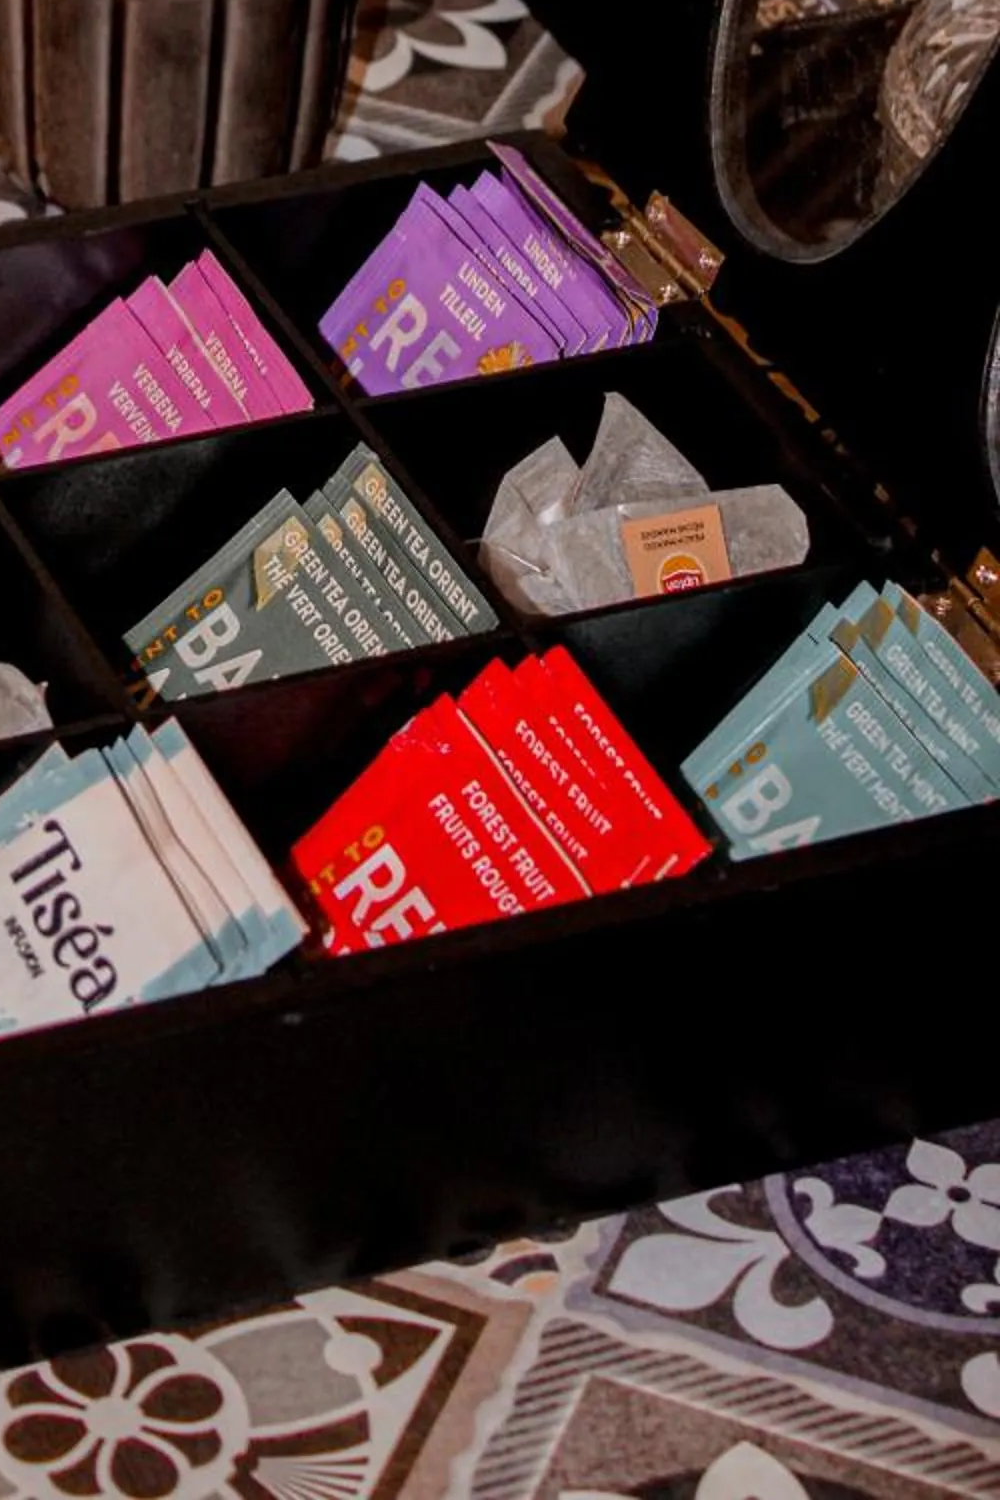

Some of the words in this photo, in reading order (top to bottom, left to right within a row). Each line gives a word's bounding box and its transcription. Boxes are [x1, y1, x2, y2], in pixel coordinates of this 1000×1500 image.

[459, 261, 506, 318] LINDEN
[523, 233, 563, 290] LINDEN
[440, 283, 487, 341] TILLEUL
[132, 363, 183, 434] VERBENA
[284, 531, 329, 586] GREEN
[321, 576, 350, 616] TEA
[346, 513, 387, 566] GREEN
[383, 557, 407, 596] TEA
[366, 479, 409, 535] GREEN
[404, 525, 431, 567] TEA
[428, 560, 480, 623] ORIENT
[263, 554, 299, 590] THÉ
[286, 583, 323, 627] VERT
[173, 601, 279, 692] BA
[887, 644, 928, 697] GREEN
[923, 684, 948, 721] TEA
[817, 716, 852, 750] THÉ
[840, 743, 880, 784] VERT
[845, 701, 890, 754] GREEN
[885, 743, 913, 781] TEA
[907, 772, 948, 813] MINT
[344, 824, 385, 862] TO
[427, 793, 481, 860] FRUITS
[461, 779, 518, 851] FOREST
[508, 846, 556, 901] FRUIT
[10, 819, 117, 1015] Tiséa
[332, 842, 447, 949] RE
[4, 915, 45, 980] INFUSION
